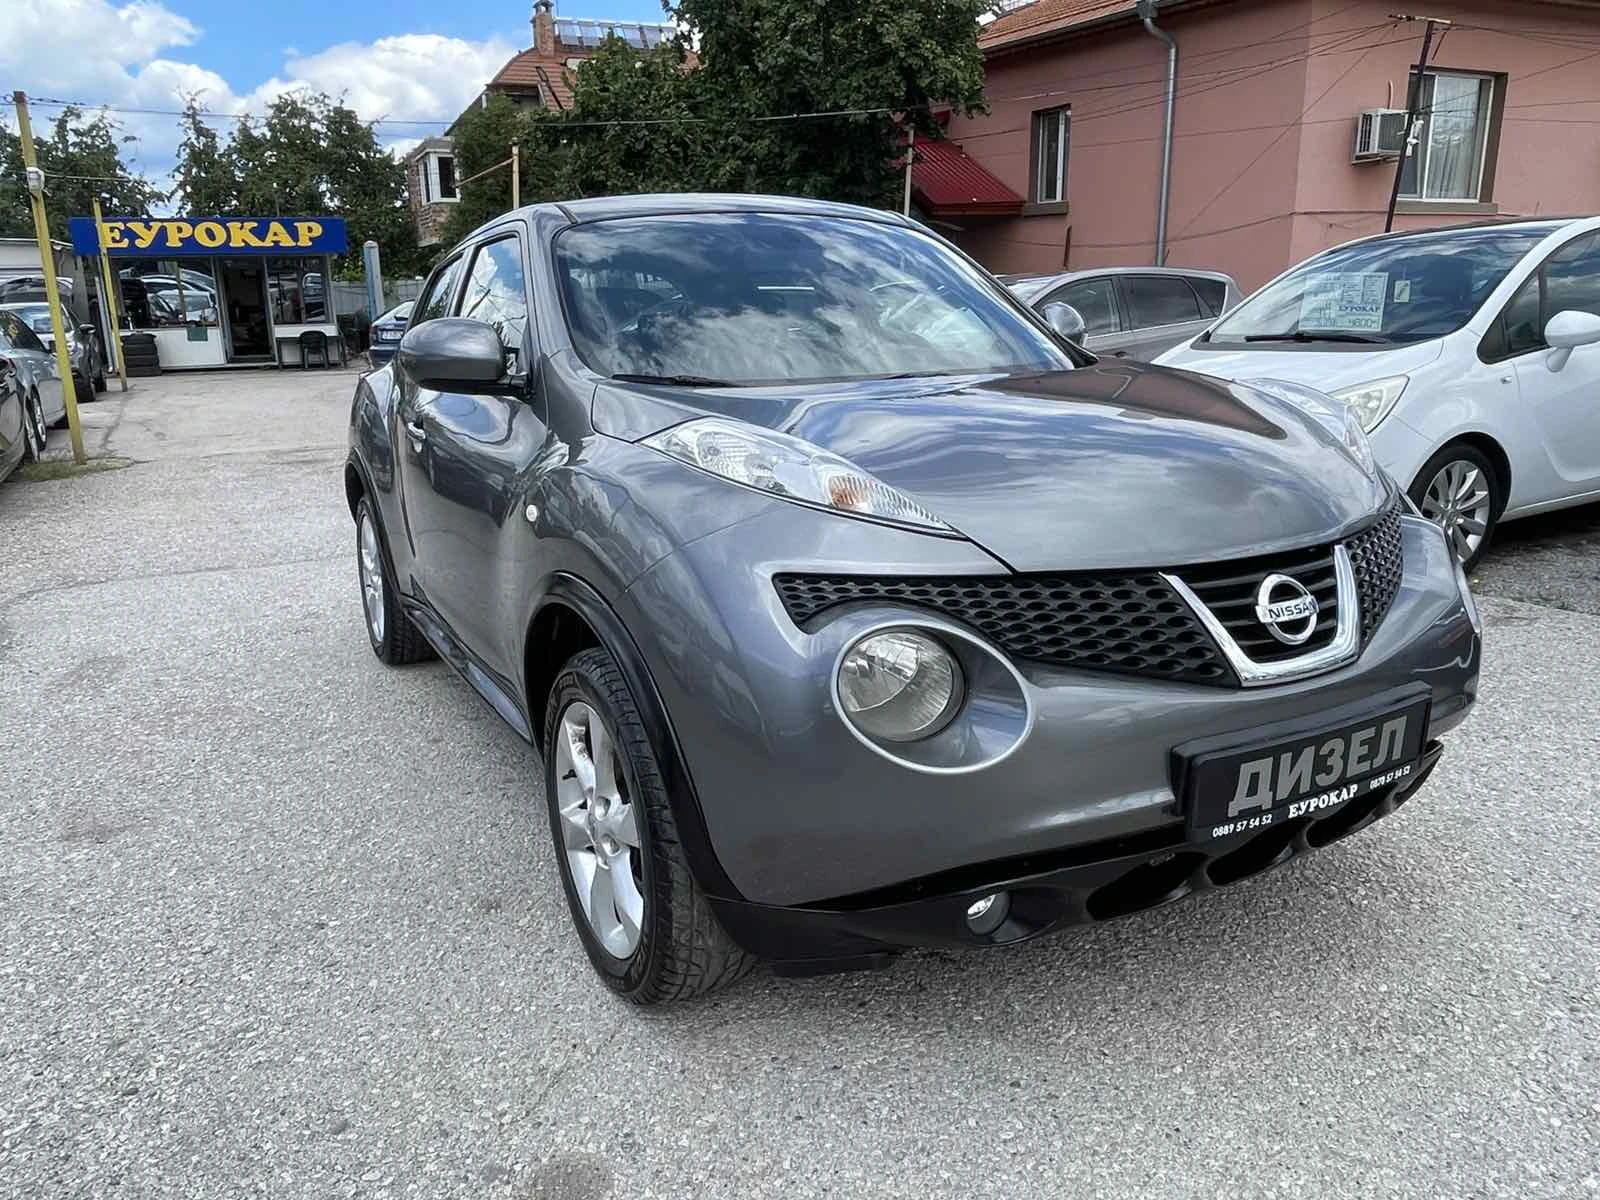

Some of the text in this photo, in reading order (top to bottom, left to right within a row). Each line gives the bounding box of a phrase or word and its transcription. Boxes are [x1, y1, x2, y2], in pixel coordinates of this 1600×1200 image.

[101, 221, 323, 248] ЕУРОКАР
[1267, 597, 1317, 619] NISSAN
[1227, 715, 1408, 818] ДИЗЕЛ
[1212, 823, 1235, 838] 0889
[1236, 820, 1248, 832] 57
[1249, 817, 1260, 828] 54
[1261, 813, 1273, 825] 52
[1287, 783, 1359, 819] ЕУРОКАР
